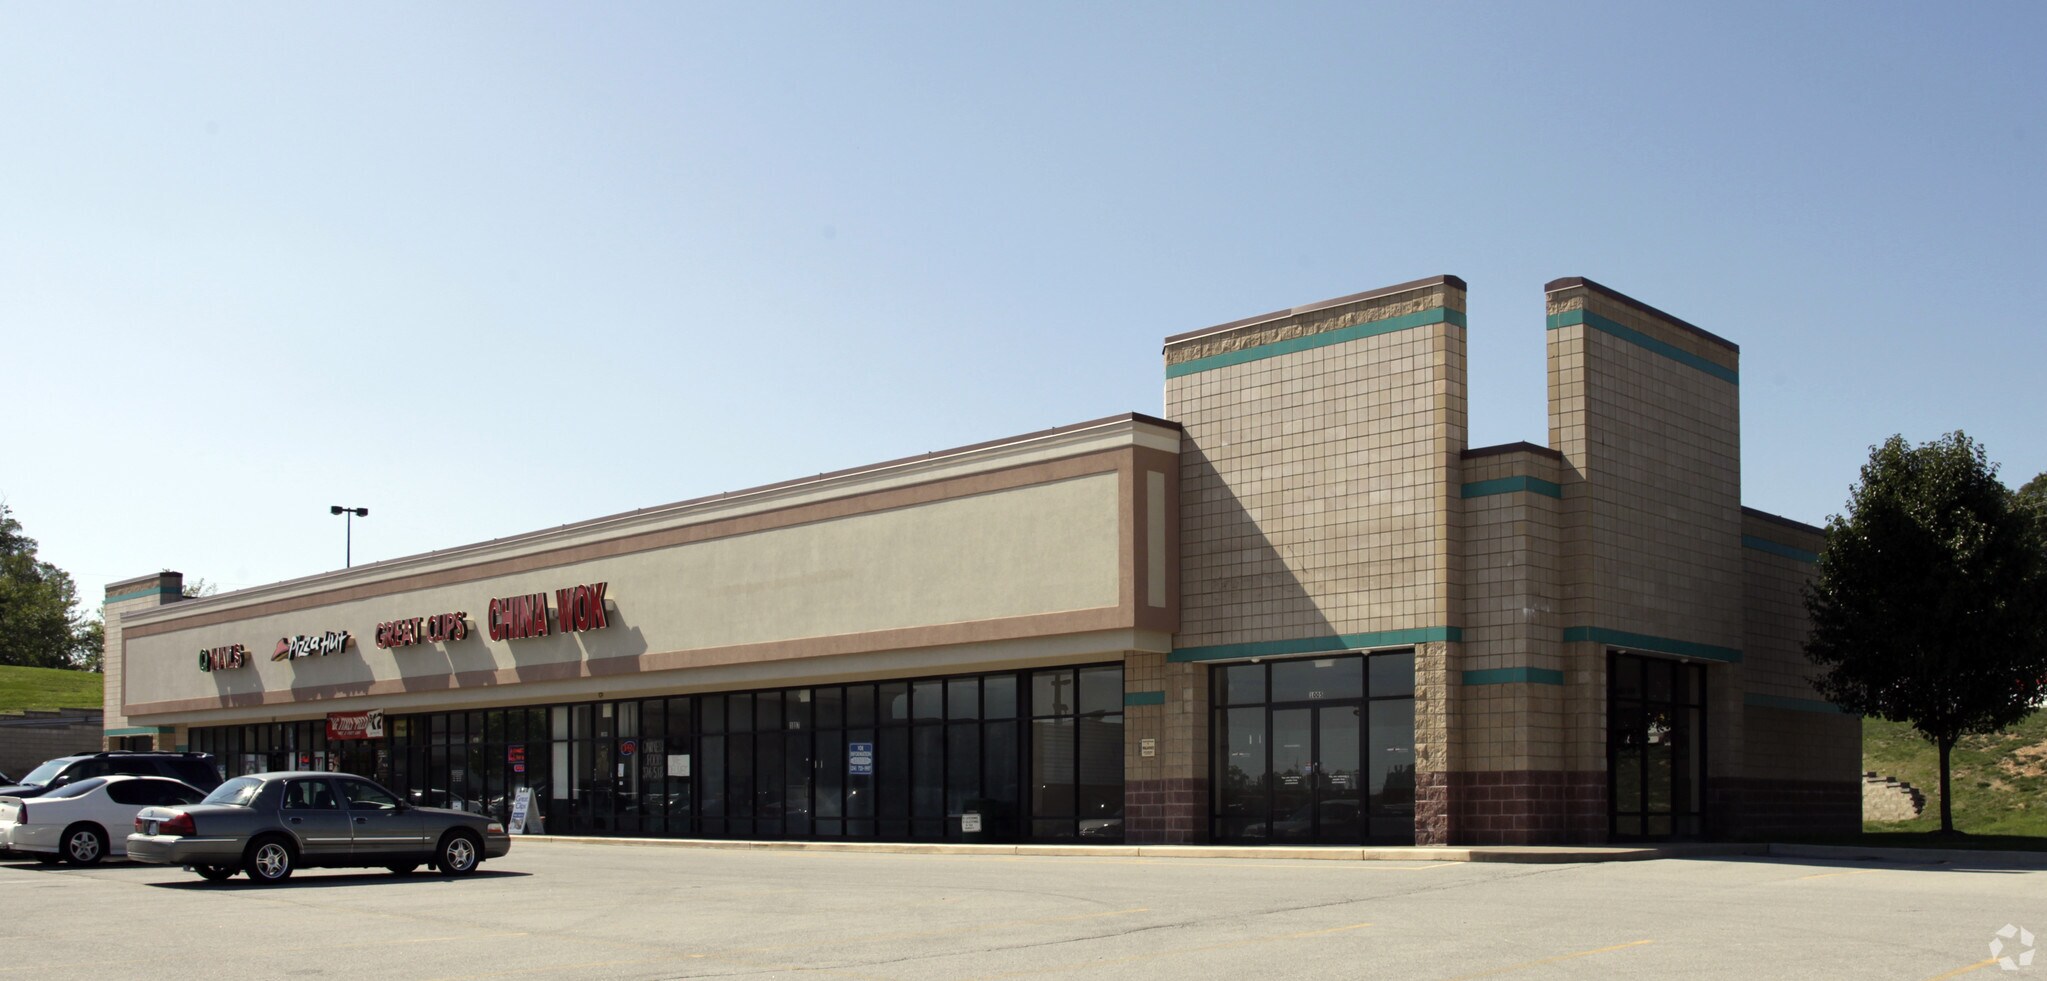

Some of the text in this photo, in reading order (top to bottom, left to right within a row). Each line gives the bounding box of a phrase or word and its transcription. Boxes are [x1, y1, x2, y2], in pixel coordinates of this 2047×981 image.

[488, 582, 608, 642] CHINA WOK
[288, 631, 349, 660] Pizza Hut
[375, 611, 467, 649] GREAT CLIPS
[211, 643, 245, 671] NAILS
